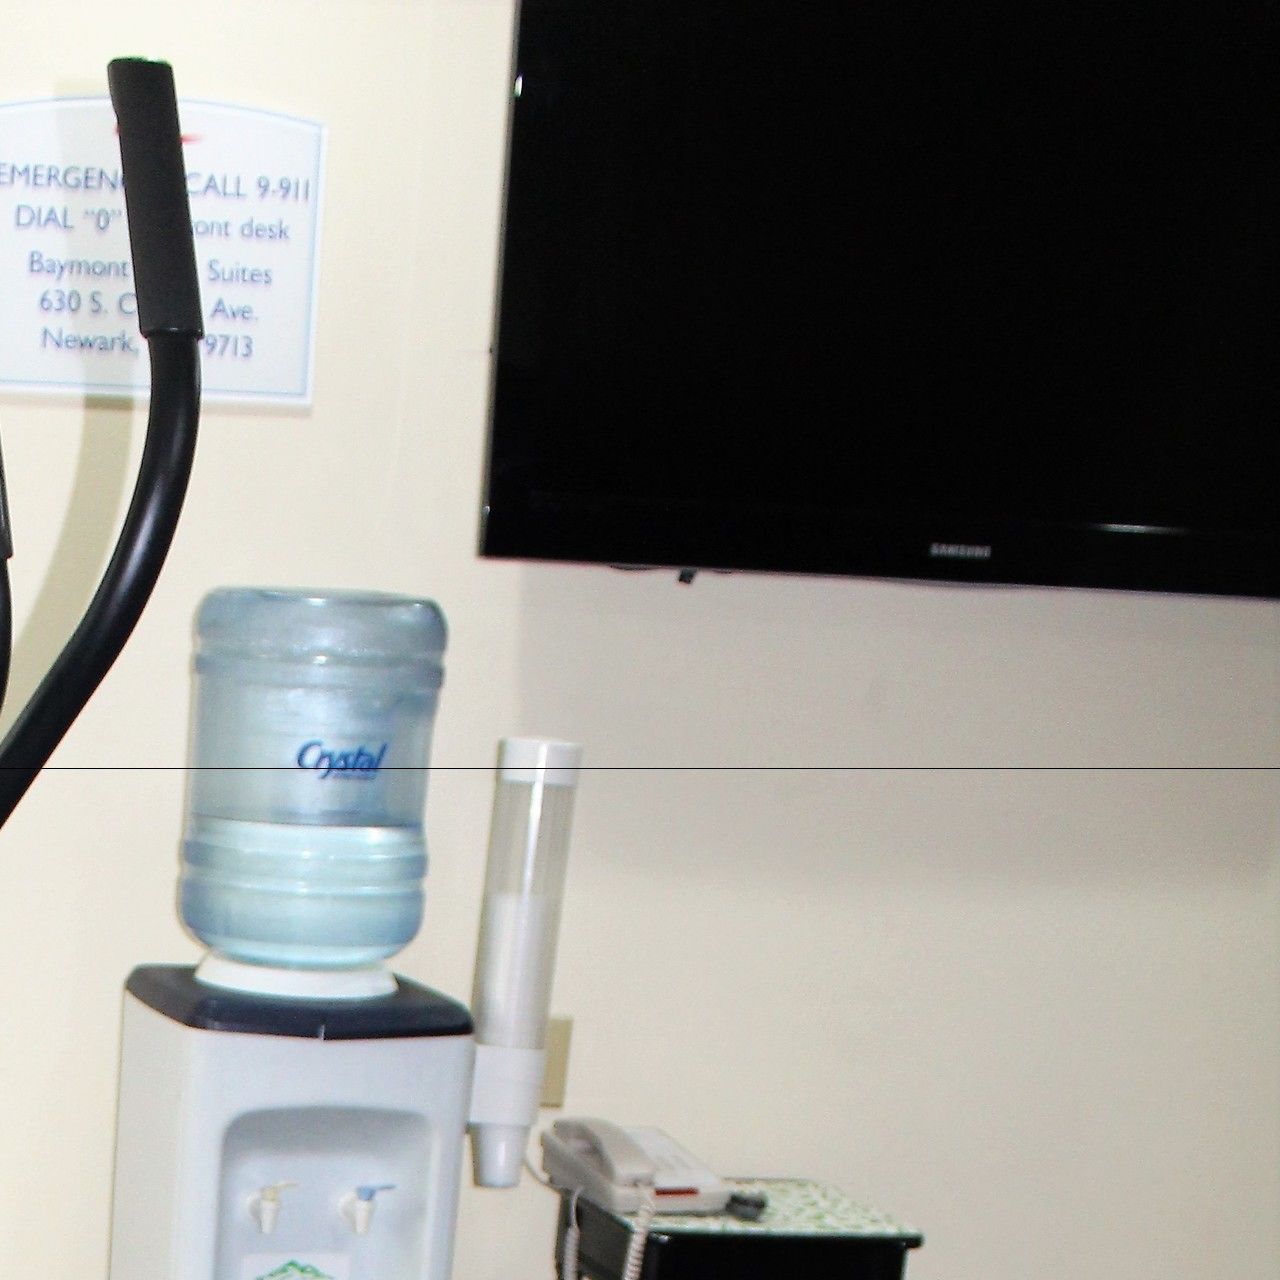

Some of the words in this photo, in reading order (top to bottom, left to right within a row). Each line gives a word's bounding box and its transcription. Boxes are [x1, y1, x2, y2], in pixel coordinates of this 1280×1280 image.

[187, 172, 247, 199] CALL
[256, 177, 310, 201] 9-911
[14, 204, 74, 230] DIAL
[192, 217, 230, 238] ont
[241, 217, 290, 241] desk
[28, 250, 128, 281] Baymont
[207, 258, 273, 284] Suites
[39, 288, 81, 314] 630
[90, 291, 109, 315] S.
[210, 299, 258, 321] Ave.
[41, 326, 139, 356] Newark,
[205, 333, 254, 358] 9713
[297, 739, 388, 779] Crystal
